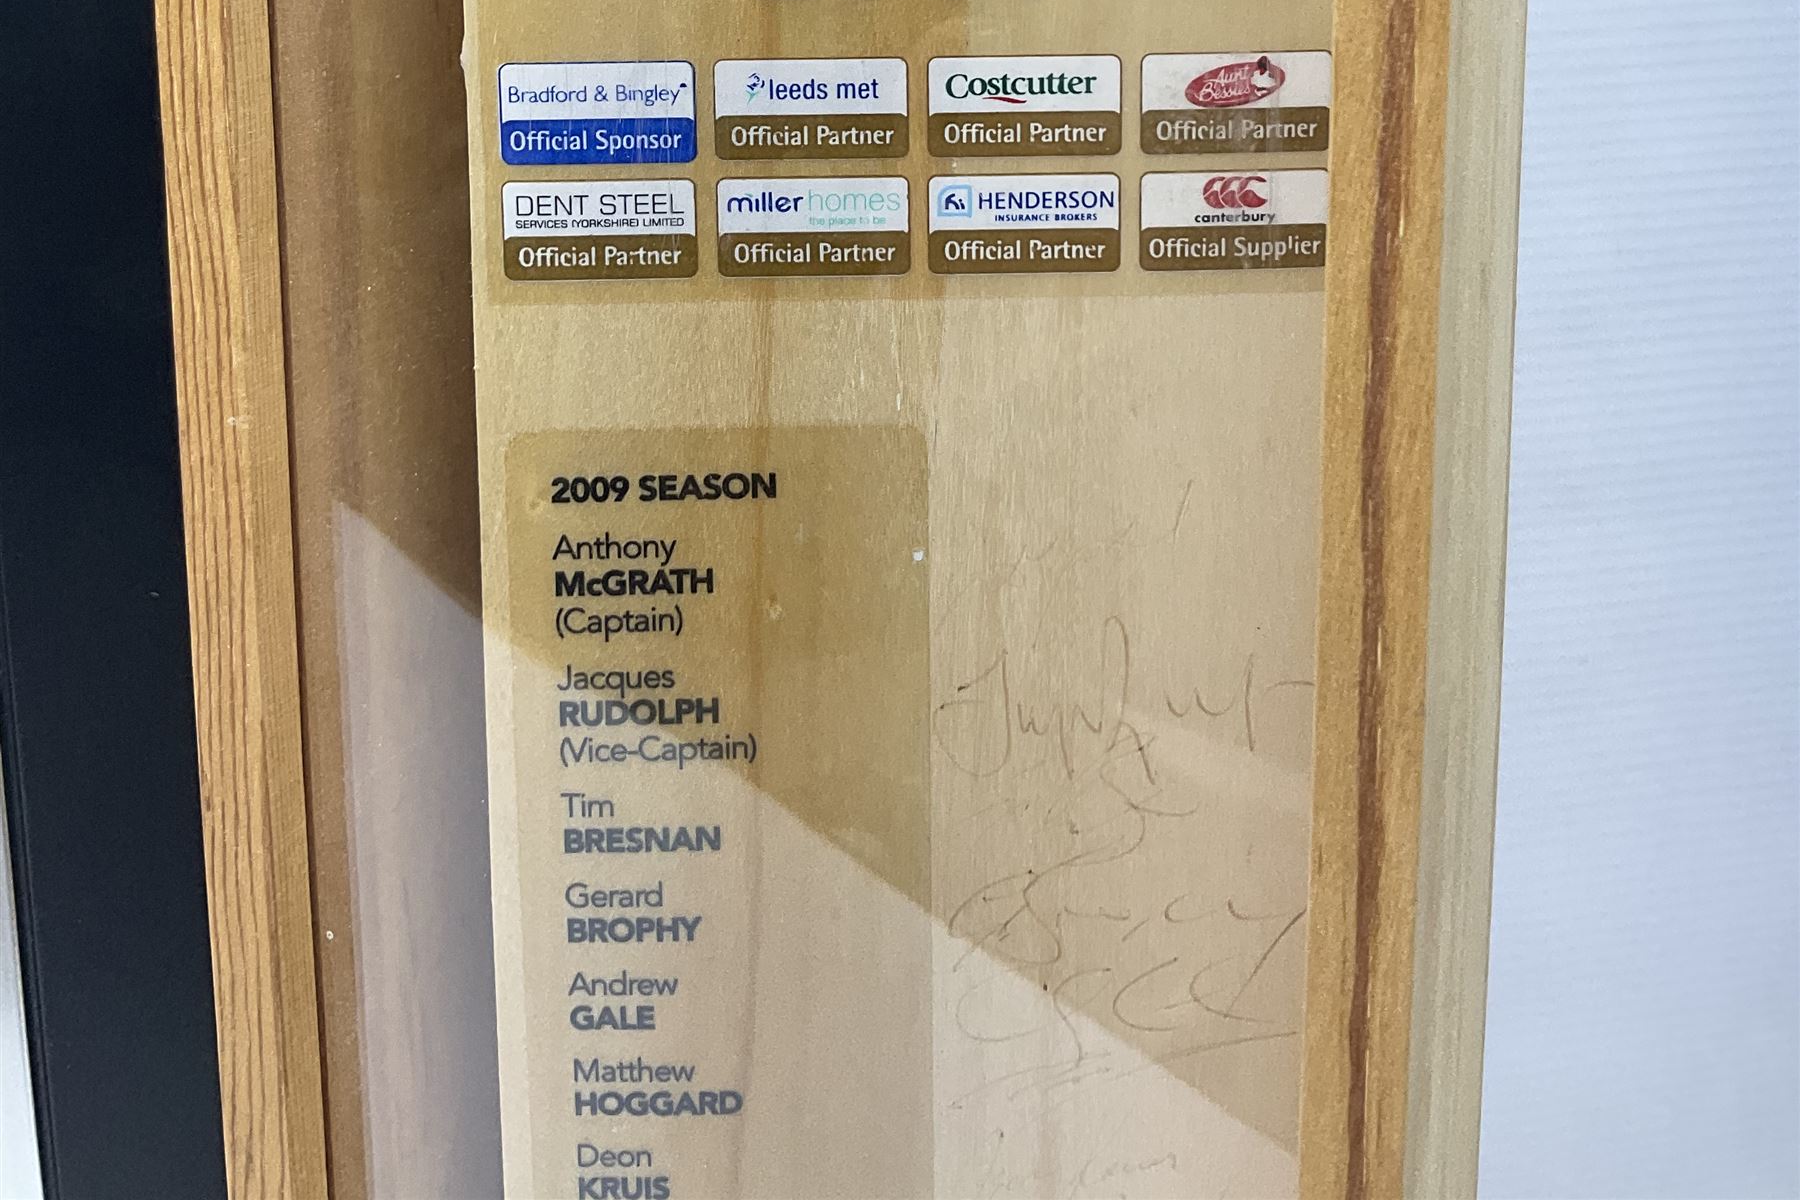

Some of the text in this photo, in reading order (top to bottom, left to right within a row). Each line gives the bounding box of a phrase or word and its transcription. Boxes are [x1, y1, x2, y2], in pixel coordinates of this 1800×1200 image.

[508, 84, 682, 106] Bradford & Bingley
[769, 78, 879, 101] leeds met
[945, 72, 1097, 99] Costcutter
[510, 129, 682, 155] Official Sponsor
[731, 124, 894, 147] Official Partner
[944, 122, 1107, 145] Official Partner
[1156, 119, 1318, 141] Official Partner
[515, 193, 685, 216] DENT STEEL
[727, 189, 900, 213] miller homes
[978, 191, 1115, 210] HENDERSON
[515, 217, 685, 229] SERVICES (YORKSHIRE) LIMITED
[809, 216, 825, 226] the
[828, 216, 856, 228] place
[873, 216, 886, 225] be
[994, 213, 1098, 222] INSURANCE BROKERS
[1194, 210, 1276, 224] canterbury
[518, 245, 682, 267] Official Partner
[734, 242, 896, 263] Official Partner
[944, 239, 1106, 261] Official Partner
[1149, 235, 1321, 261] Official Supplier
[551, 472, 777, 504] 2009 SEASON
[552, 532, 677, 567] Anthony
[555, 568, 714, 597] McGRATH
[555, 605, 683, 642] (Captain)
[557, 665, 675, 698] Jacques
[559, 698, 720, 727] RUDOLPH
[559, 733, 757, 770] (Vice-Captain)
[560, 792, 614, 818] Tim
[563, 826, 721, 854] BRESNAN
[564, 881, 664, 908] Gerard
[566, 916, 702, 943] BROPHY
[568, 970, 679, 997] Andrew
[569, 1005, 656, 1031] GALE
[572, 1057, 695, 1083] Matthew
[574, 1090, 744, 1117] HOGGARD
[577, 1143, 652, 1168] Deon
[578, 1176, 670, 1200] KRUIS
